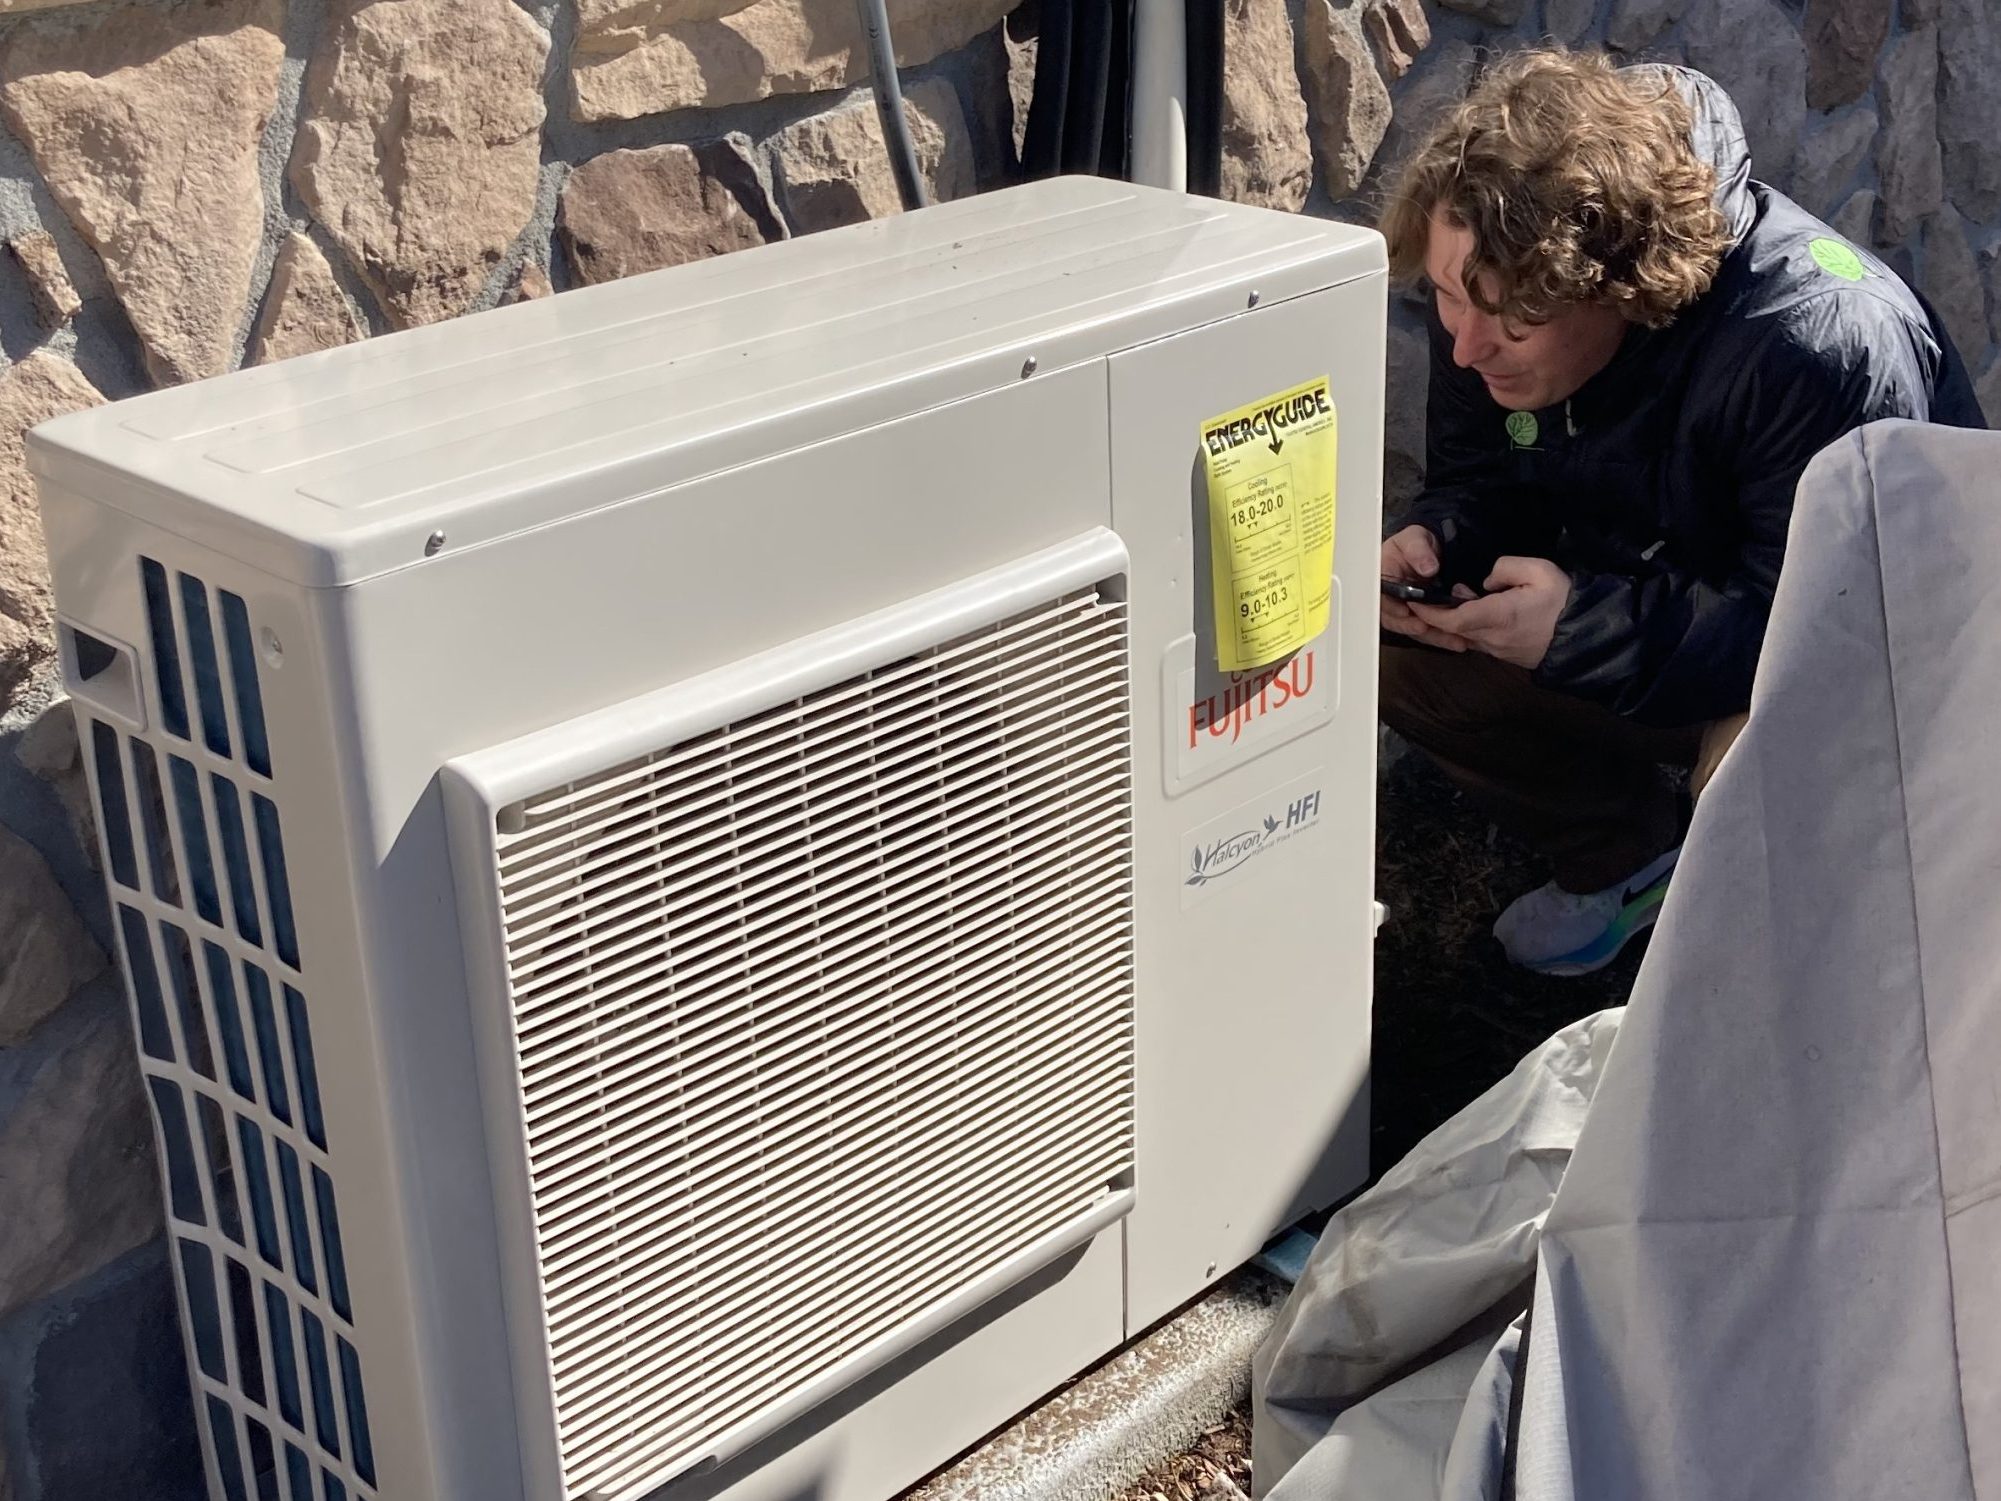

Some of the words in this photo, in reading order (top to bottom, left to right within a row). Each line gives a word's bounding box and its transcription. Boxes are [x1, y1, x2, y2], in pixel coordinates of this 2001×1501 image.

[1206, 388, 1331, 456] ENERGYGUIDE
[1232, 494, 1257, 508] Efficiency
[1258, 486, 1274, 497] Rating
[1248, 477, 1268, 490] Cooling
[1230, 494, 1284, 527] 18.0-20.0
[1258, 570, 1277, 582] Heating
[1240, 586, 1267, 600] Efficiency
[1240, 587, 1288, 617] 9.0-10.3
[1188, 651, 1314, 750] FUJITSU
[1202, 832, 1261, 872] Halcyon
[1285, 790, 1321, 829] HFI
